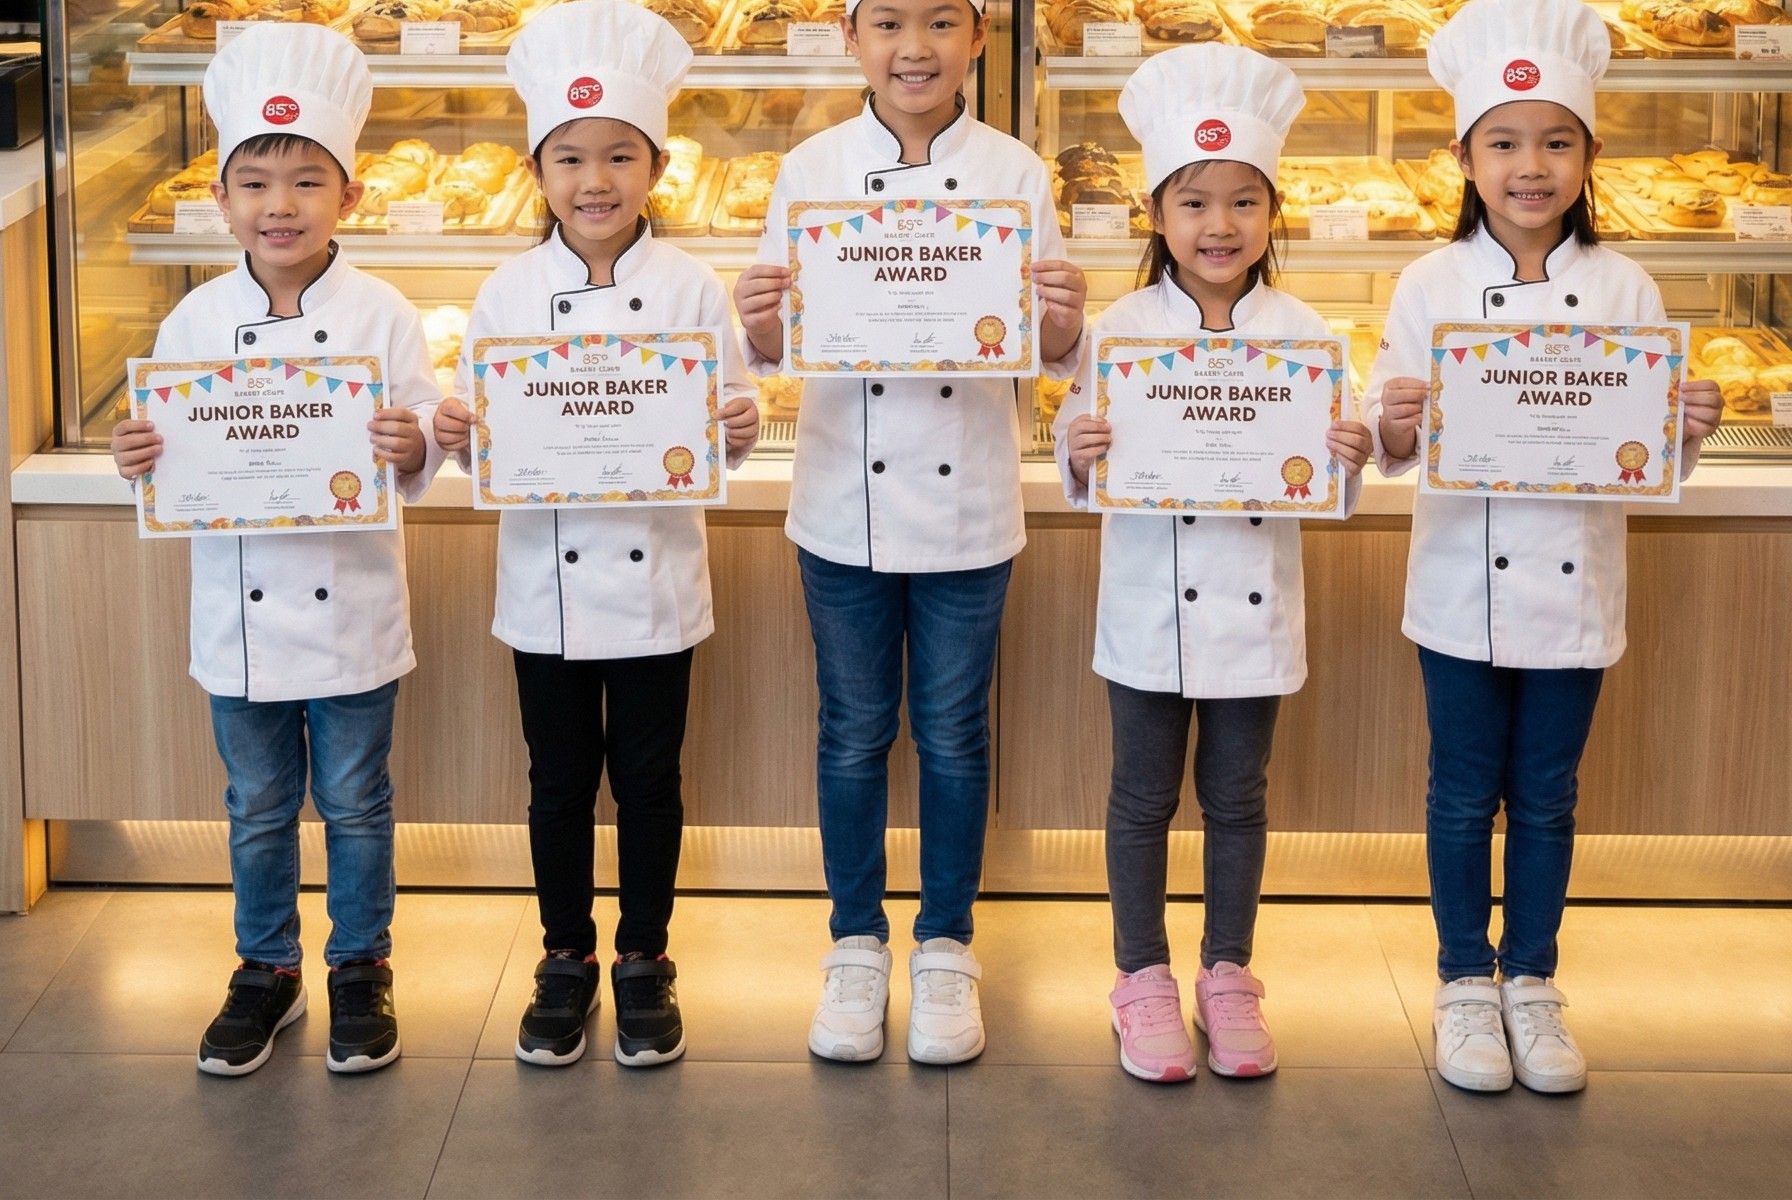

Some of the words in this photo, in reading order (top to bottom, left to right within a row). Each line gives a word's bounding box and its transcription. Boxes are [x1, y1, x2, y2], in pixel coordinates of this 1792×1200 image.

[836, 246, 913, 262] JUNIOR
[919, 246, 982, 262] BAKER
[874, 266, 947, 282] AWARD
[1480, 369, 1558, 386] JUNIOR
[1564, 370, 1628, 387] BAKER
[523, 381, 600, 397] JUNIOR
[605, 379, 668, 395] BAKER
[1145, 384, 1222, 401] JUNIOR
[1228, 386, 1292, 402] BAKER
[1516, 390, 1593, 407] AWARD
[187, 404, 265, 422] JUNIOR
[270, 403, 334, 419] BAKER
[561, 400, 635, 417] AWARD
[1182, 406, 1257, 422] AWARD
[225, 424, 301, 441] AWARD
